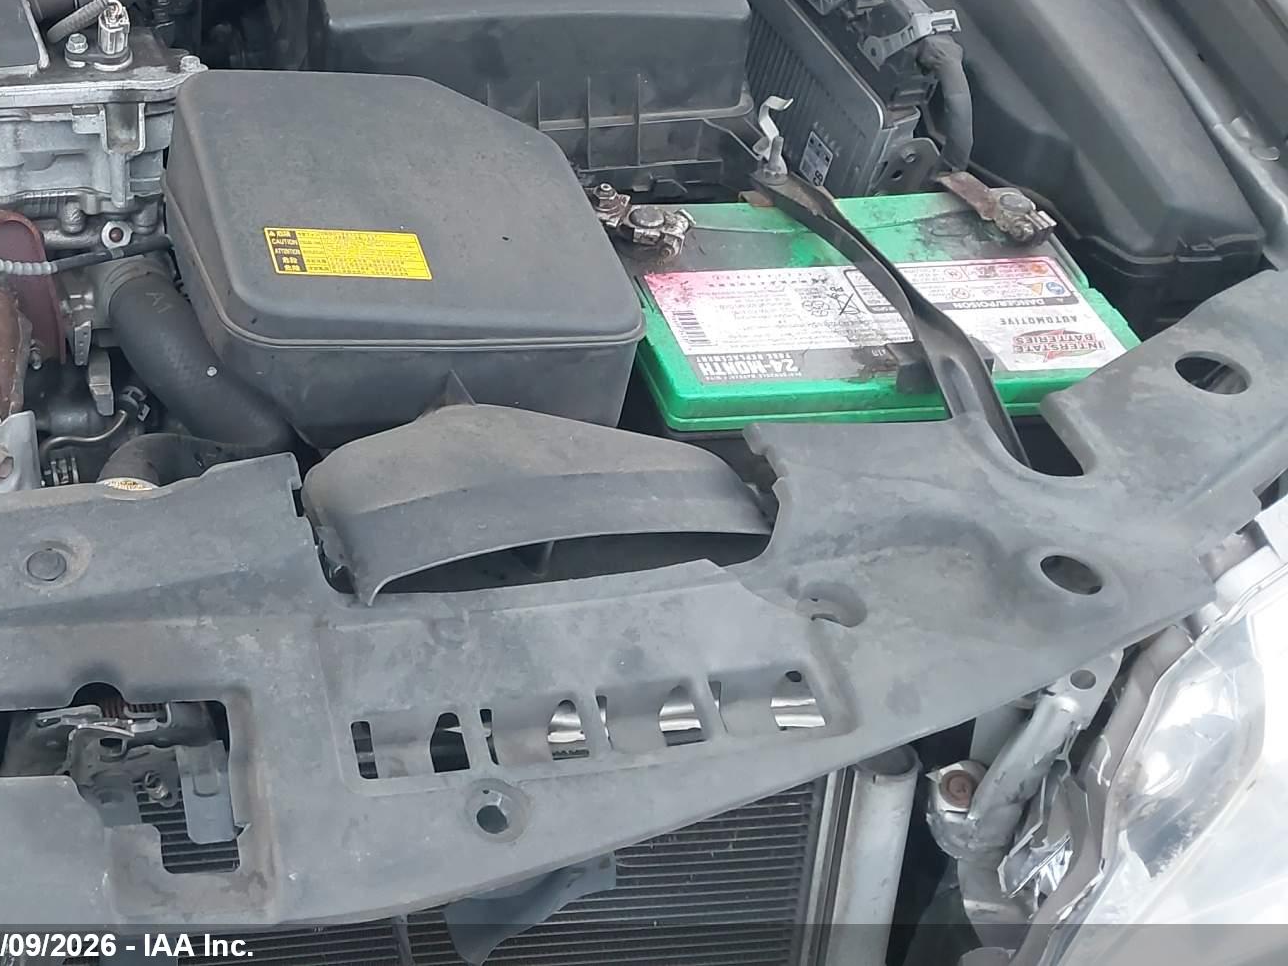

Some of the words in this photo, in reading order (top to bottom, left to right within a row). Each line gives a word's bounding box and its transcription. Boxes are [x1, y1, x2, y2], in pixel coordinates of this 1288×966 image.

[271, 238, 298, 246] CAUTION
[952, 298, 1045, 310] DANGER/POISON
[999, 315, 1078, 326] AUTOMOTIVE
[1014, 333, 1094, 345] BATTERIES
[1013, 340, 1104, 354] INTERSTATE
[697, 358, 798, 376] 24-MONTH
